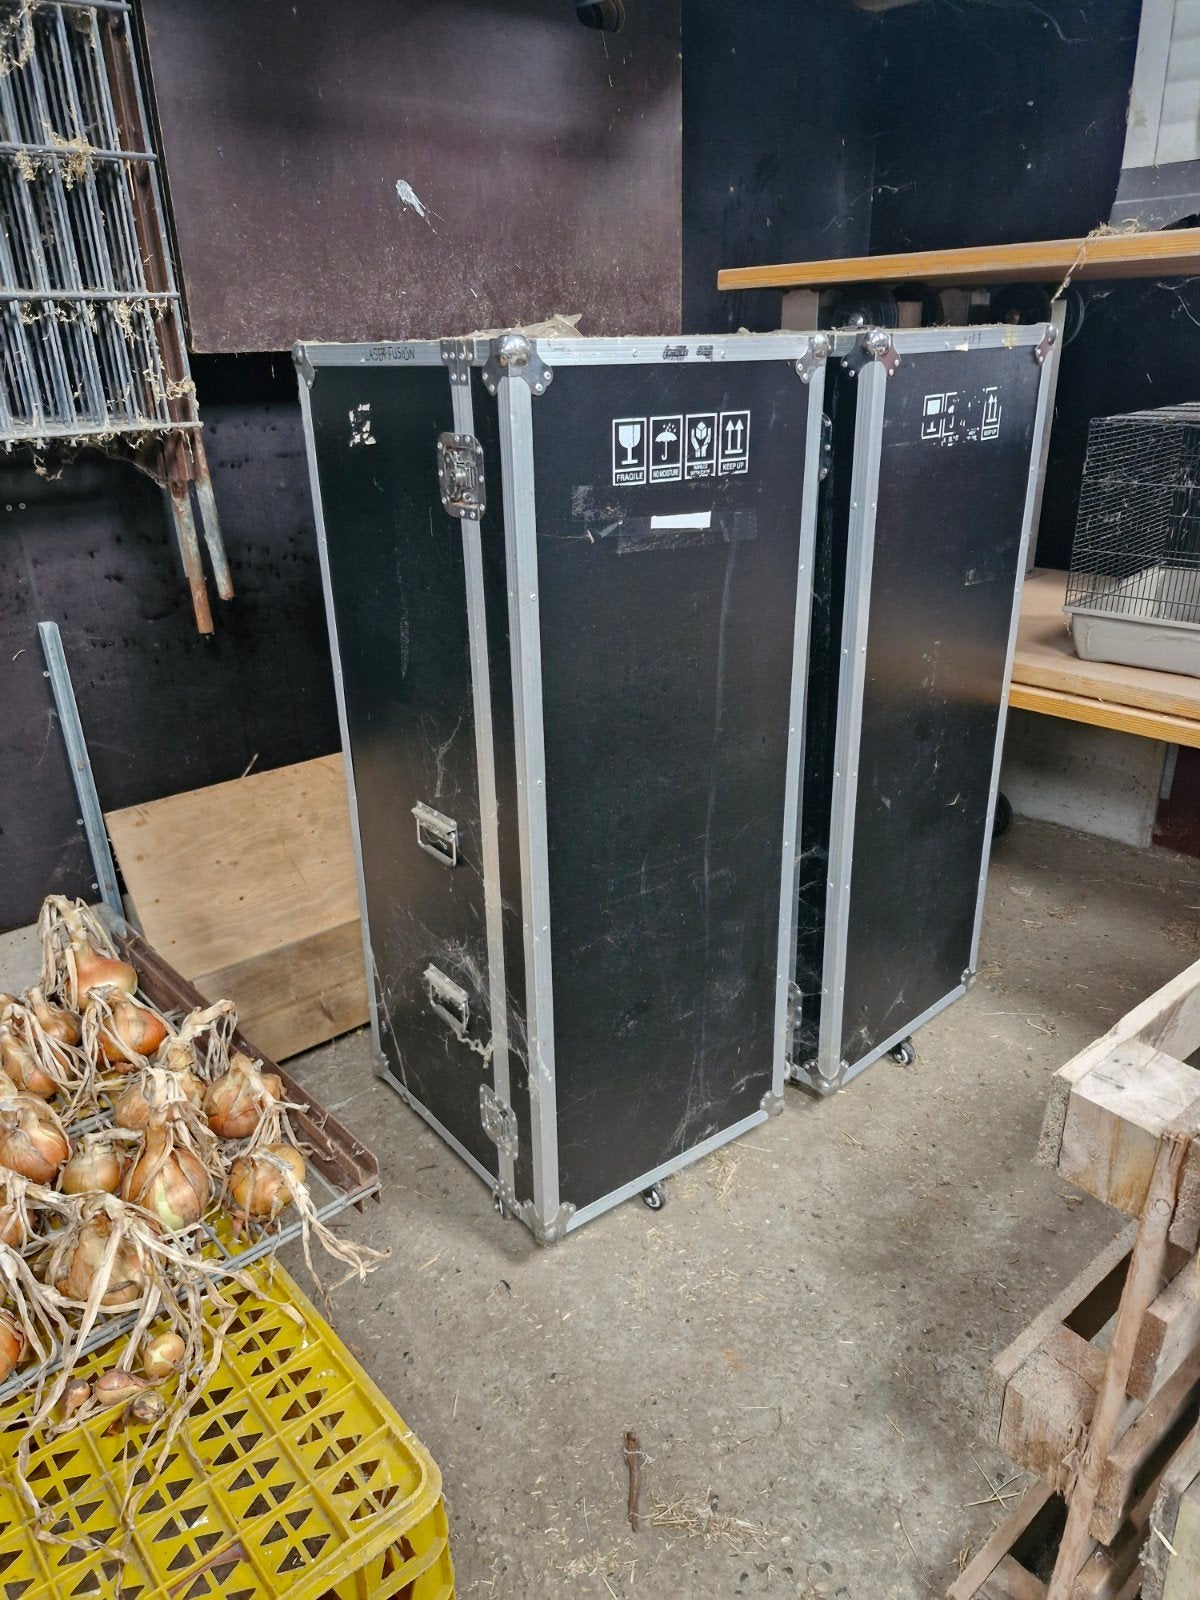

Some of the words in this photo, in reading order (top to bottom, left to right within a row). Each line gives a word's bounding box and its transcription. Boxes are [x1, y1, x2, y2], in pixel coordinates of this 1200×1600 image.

[388, 346, 415, 361] FUSION
[722, 463, 736, 471] KEEP
[736, 461, 745, 470] UP
[616, 471, 644, 482] FRAGILE
[652, 470, 660, 478] NO
